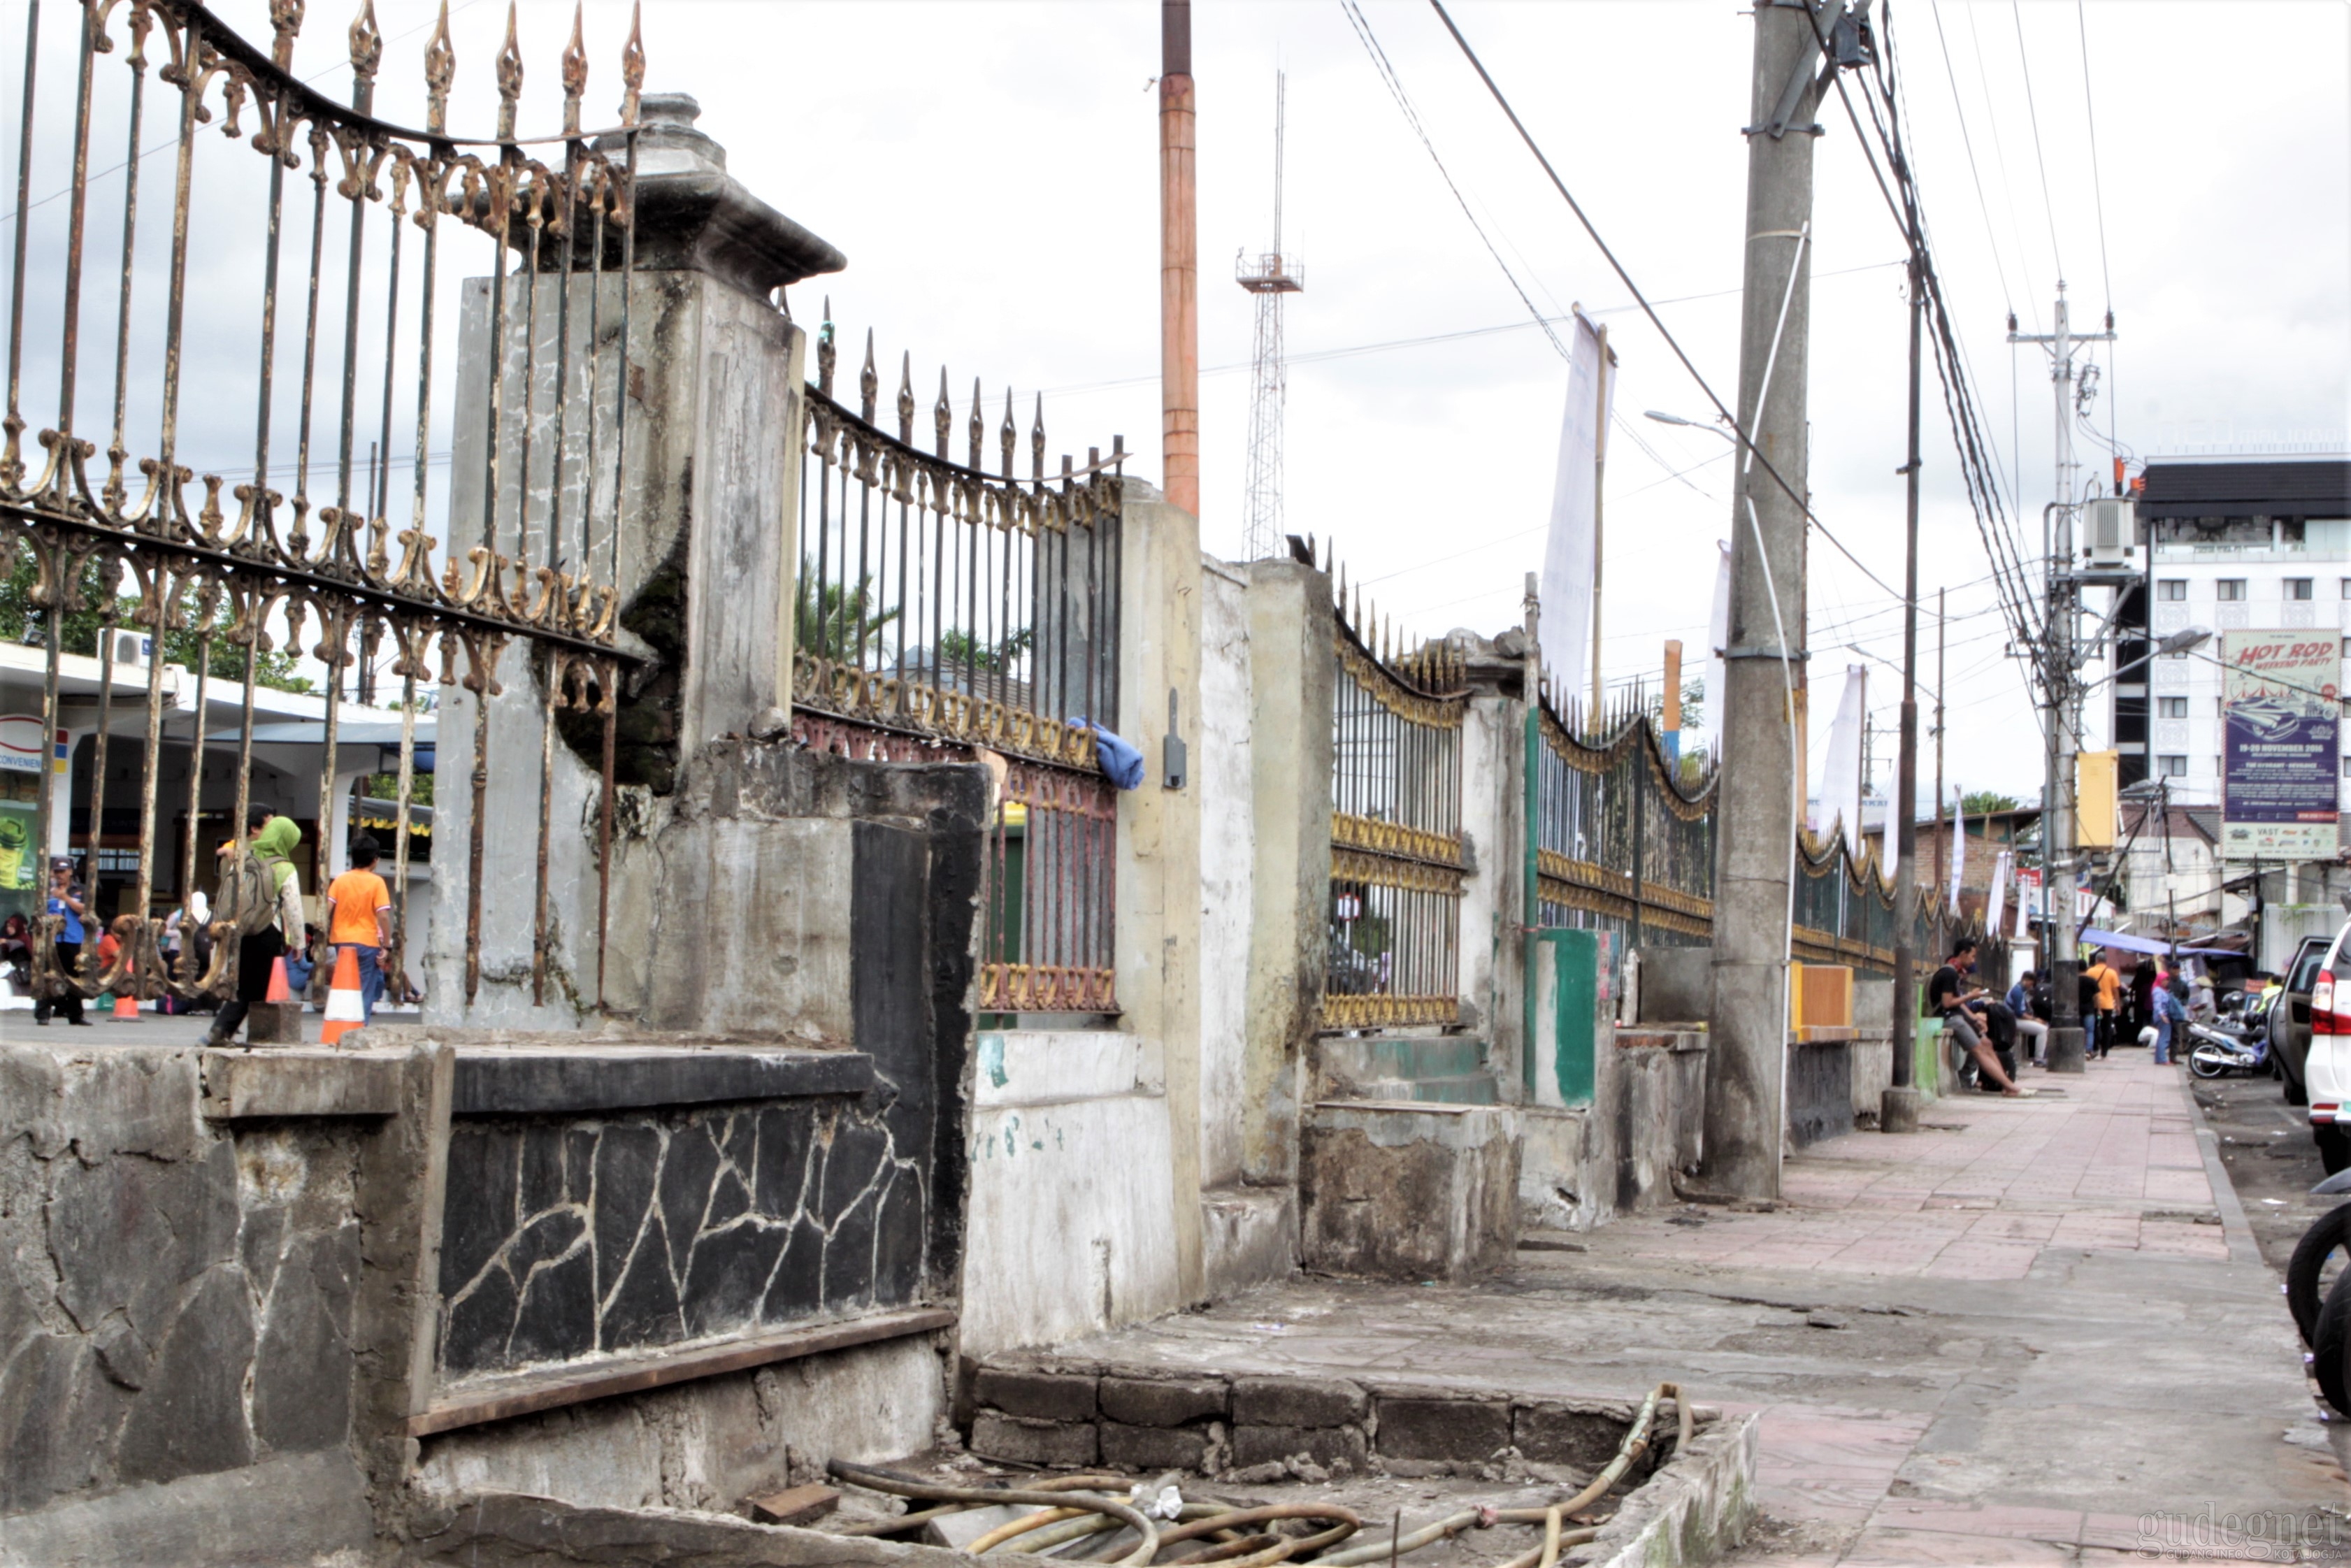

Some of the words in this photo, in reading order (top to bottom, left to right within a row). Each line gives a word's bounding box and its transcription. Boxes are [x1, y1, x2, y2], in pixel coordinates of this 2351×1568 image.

[2237, 643, 2286, 666] HOT
[2288, 641, 2334, 658] ROD
[2255, 659, 2299, 670] WEEKEND
[2299, 656, 2334, 667] PARTY
[2239, 744, 2260, 752] 19-20
[2262, 744, 2304, 752] NOVEMBER
[2305, 744, 2324, 752] 2016
[2257, 828, 2279, 836] VAST
